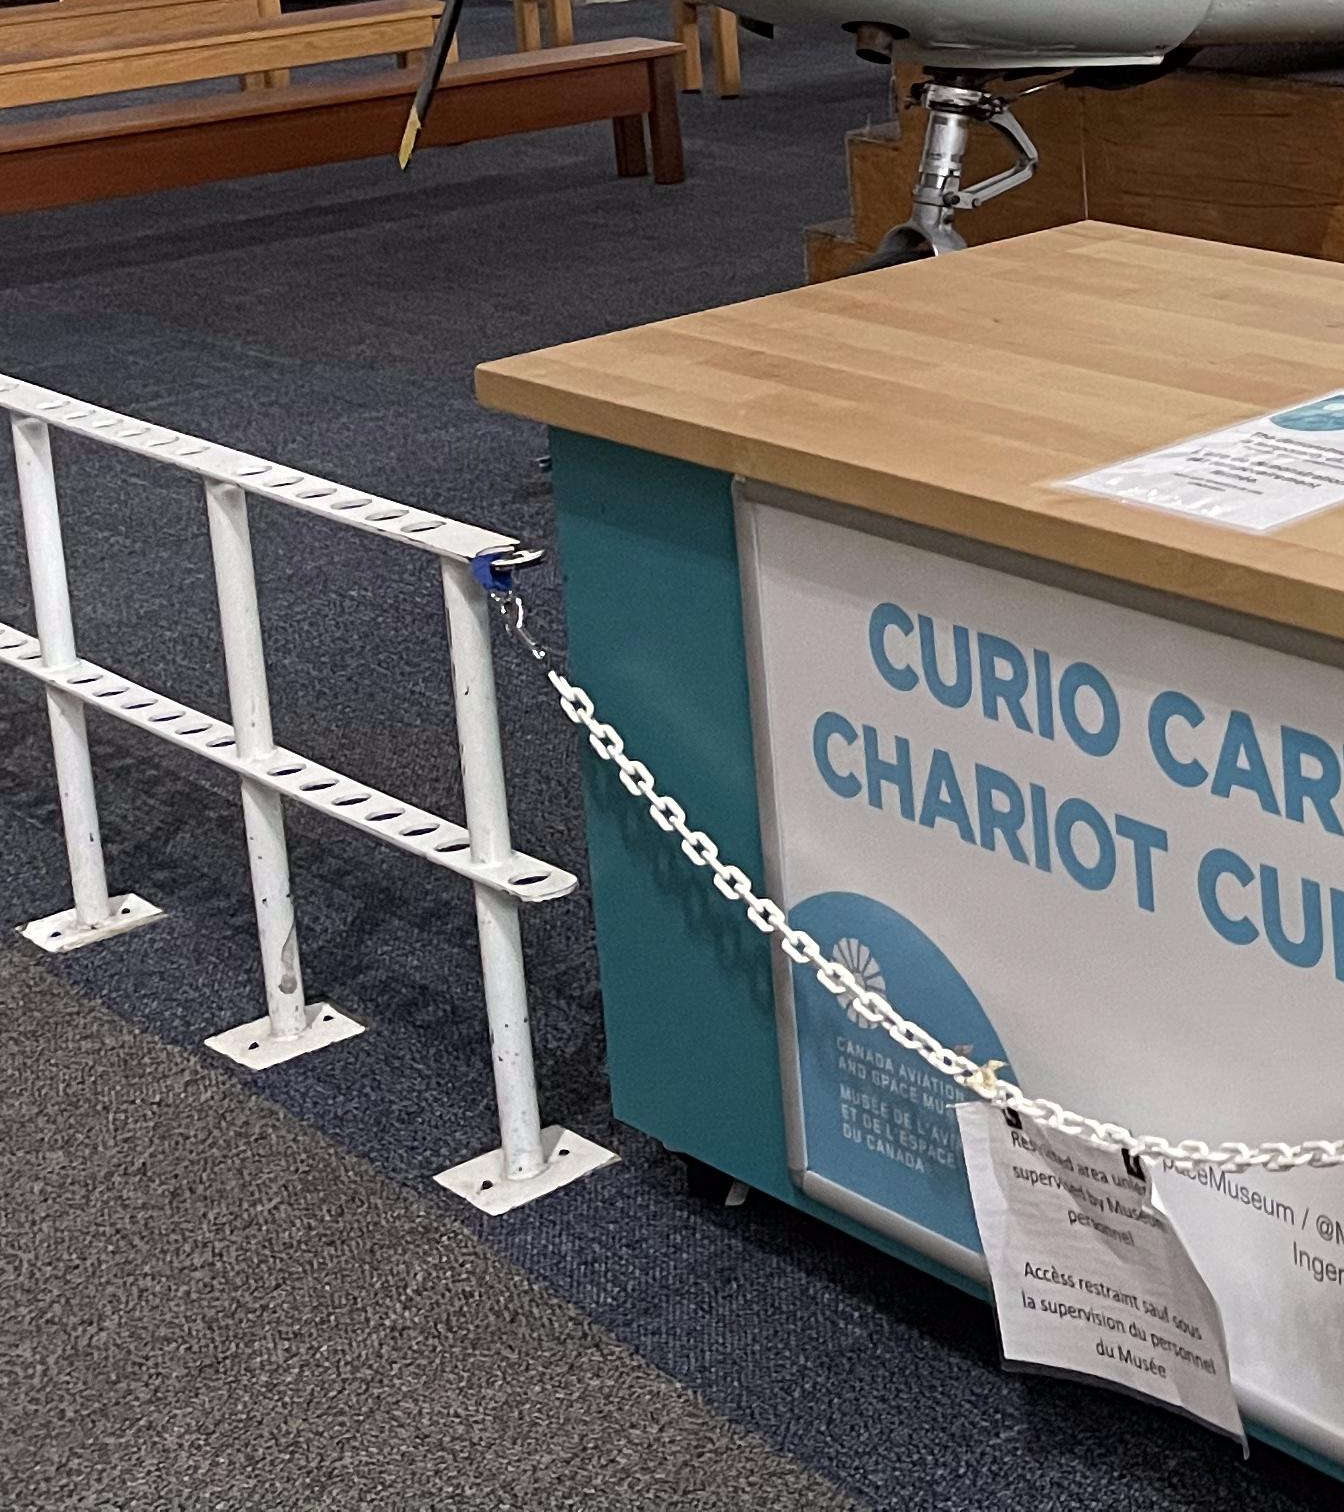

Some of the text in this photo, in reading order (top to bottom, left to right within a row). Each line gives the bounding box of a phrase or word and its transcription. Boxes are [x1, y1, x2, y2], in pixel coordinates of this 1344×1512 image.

[868, 602, 1121, 757] CURIO
[812, 711, 1168, 913] CHARIOT
[836, 1036, 965, 1102] CANADA AVIATION
[837, 1056, 866, 1080] AND
[871, 1069, 918, 1103] SPACE
[840, 1103, 857, 1122] ET
[862, 1112, 881, 1134] DE
[893, 1108, 912, 1129] DE
[842, 1122, 925, 1173] DU CANADA
[1021, 1287, 1217, 1375] la supervision du personnel
[1172, 1314, 1203, 1340] sous
[1095, 1337, 1167, 1379] du Musée
